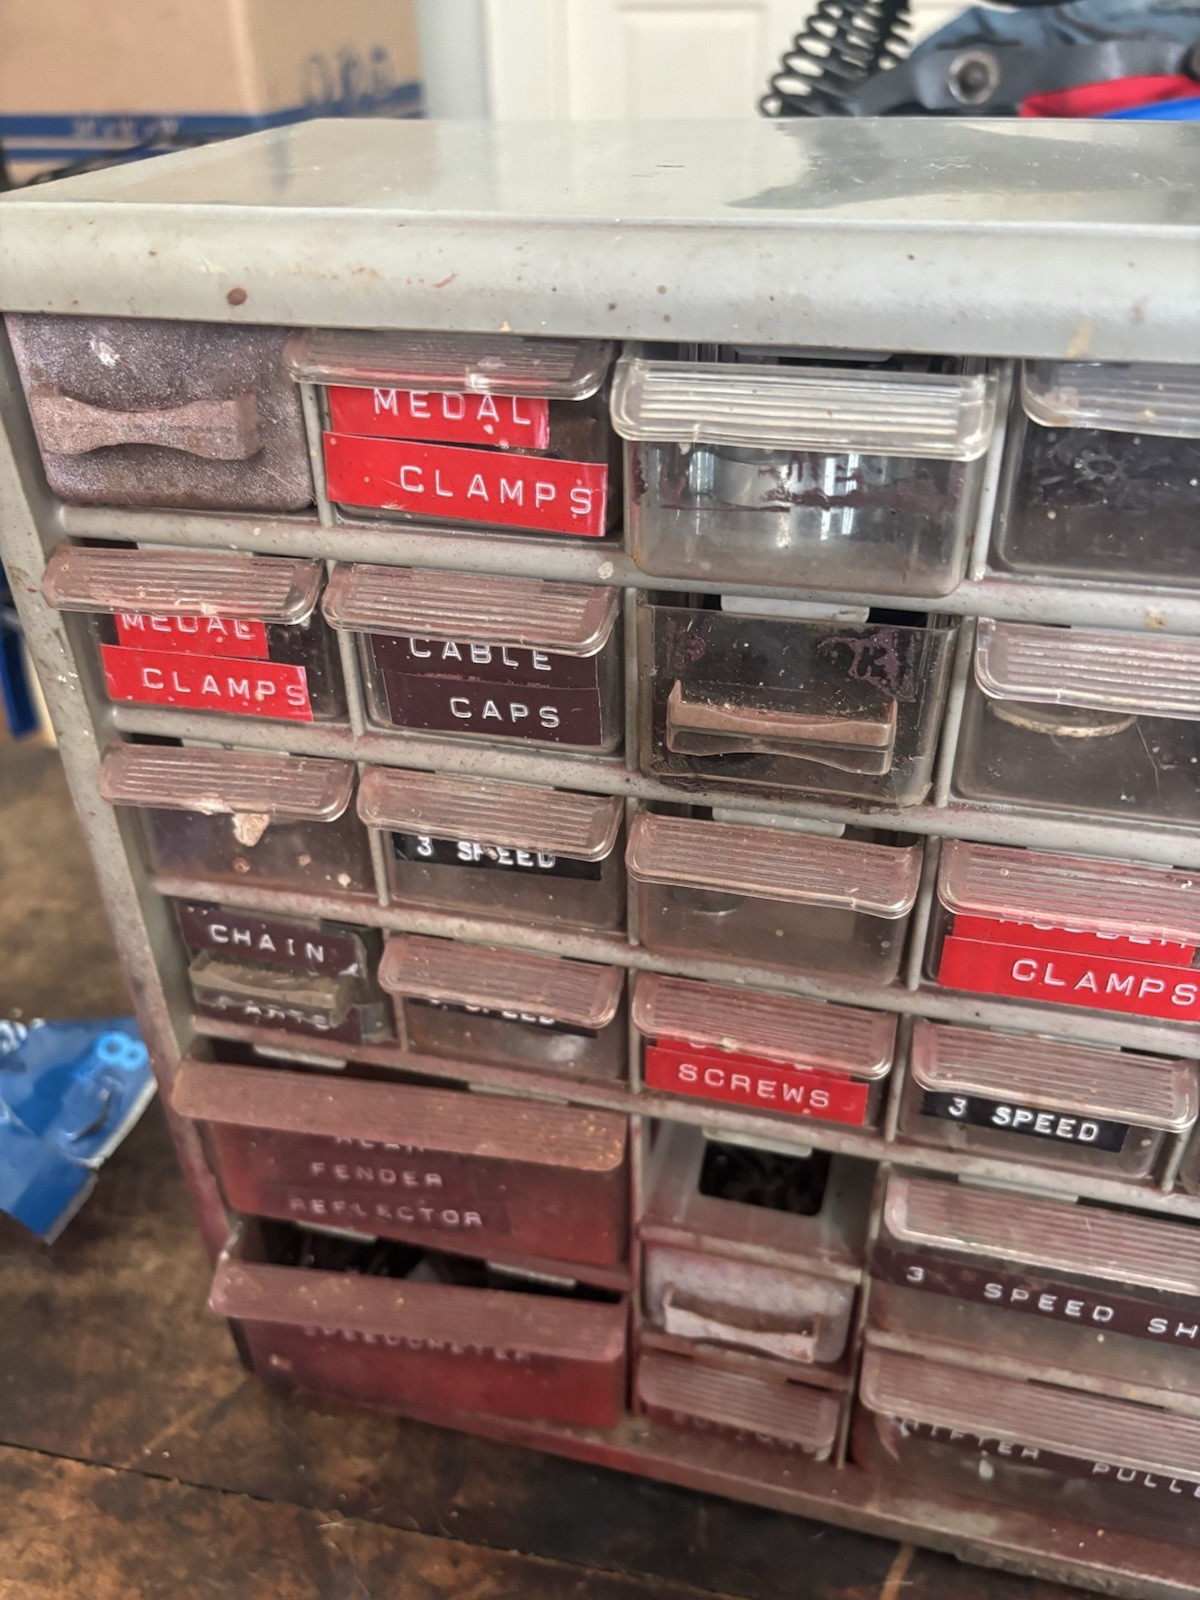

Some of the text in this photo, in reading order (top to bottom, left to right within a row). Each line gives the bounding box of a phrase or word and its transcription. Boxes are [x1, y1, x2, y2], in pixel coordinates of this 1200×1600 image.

[373, 387, 532, 425] MEDAL
[399, 464, 593, 515] CLAMPS
[120, 612, 256, 640] MEDAL
[408, 636, 552, 672] CABLE
[141, 667, 306, 706] CLAMPS
[449, 696, 561, 728] CAPS
[416, 835, 433, 857] 3
[207, 923, 325, 963] CHAIN
[1011, 958, 1199, 1006] CLAMPS
[677, 1062, 831, 1109] SCREWS
[947, 1097, 1100, 1143] 3 SPEED
[310, 1161, 444, 1188] FENDER
[289, 1197, 484, 1227] REFLECTOR
[905, 1266, 926, 1283] 3
[982, 1281, 1116, 1324] SPEED
